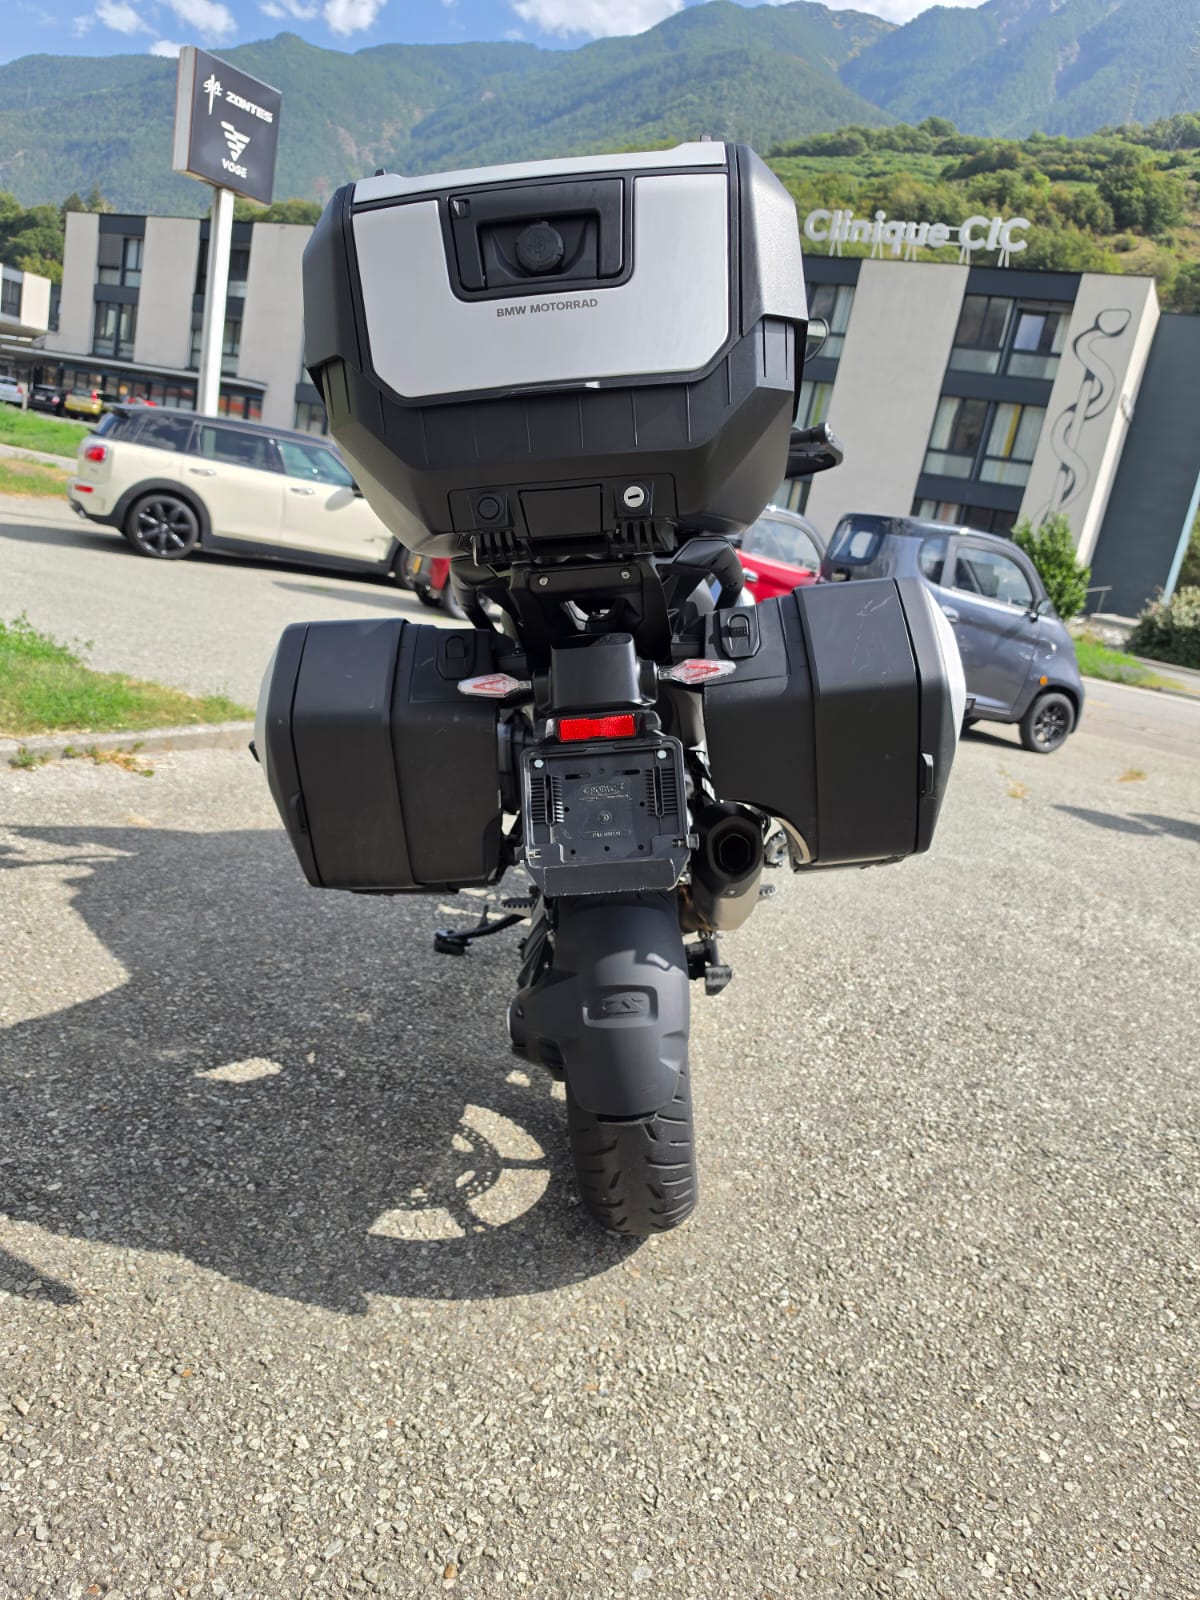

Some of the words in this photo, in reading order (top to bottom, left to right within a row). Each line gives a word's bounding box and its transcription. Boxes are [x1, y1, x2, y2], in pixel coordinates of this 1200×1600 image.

[225, 91, 273, 123] ZONTES
[803, 208, 950, 255] Clinique
[958, 215, 1031, 251] CIC
[496, 305, 527, 318] BMW
[530, 298, 599, 314] MOTORRAD
